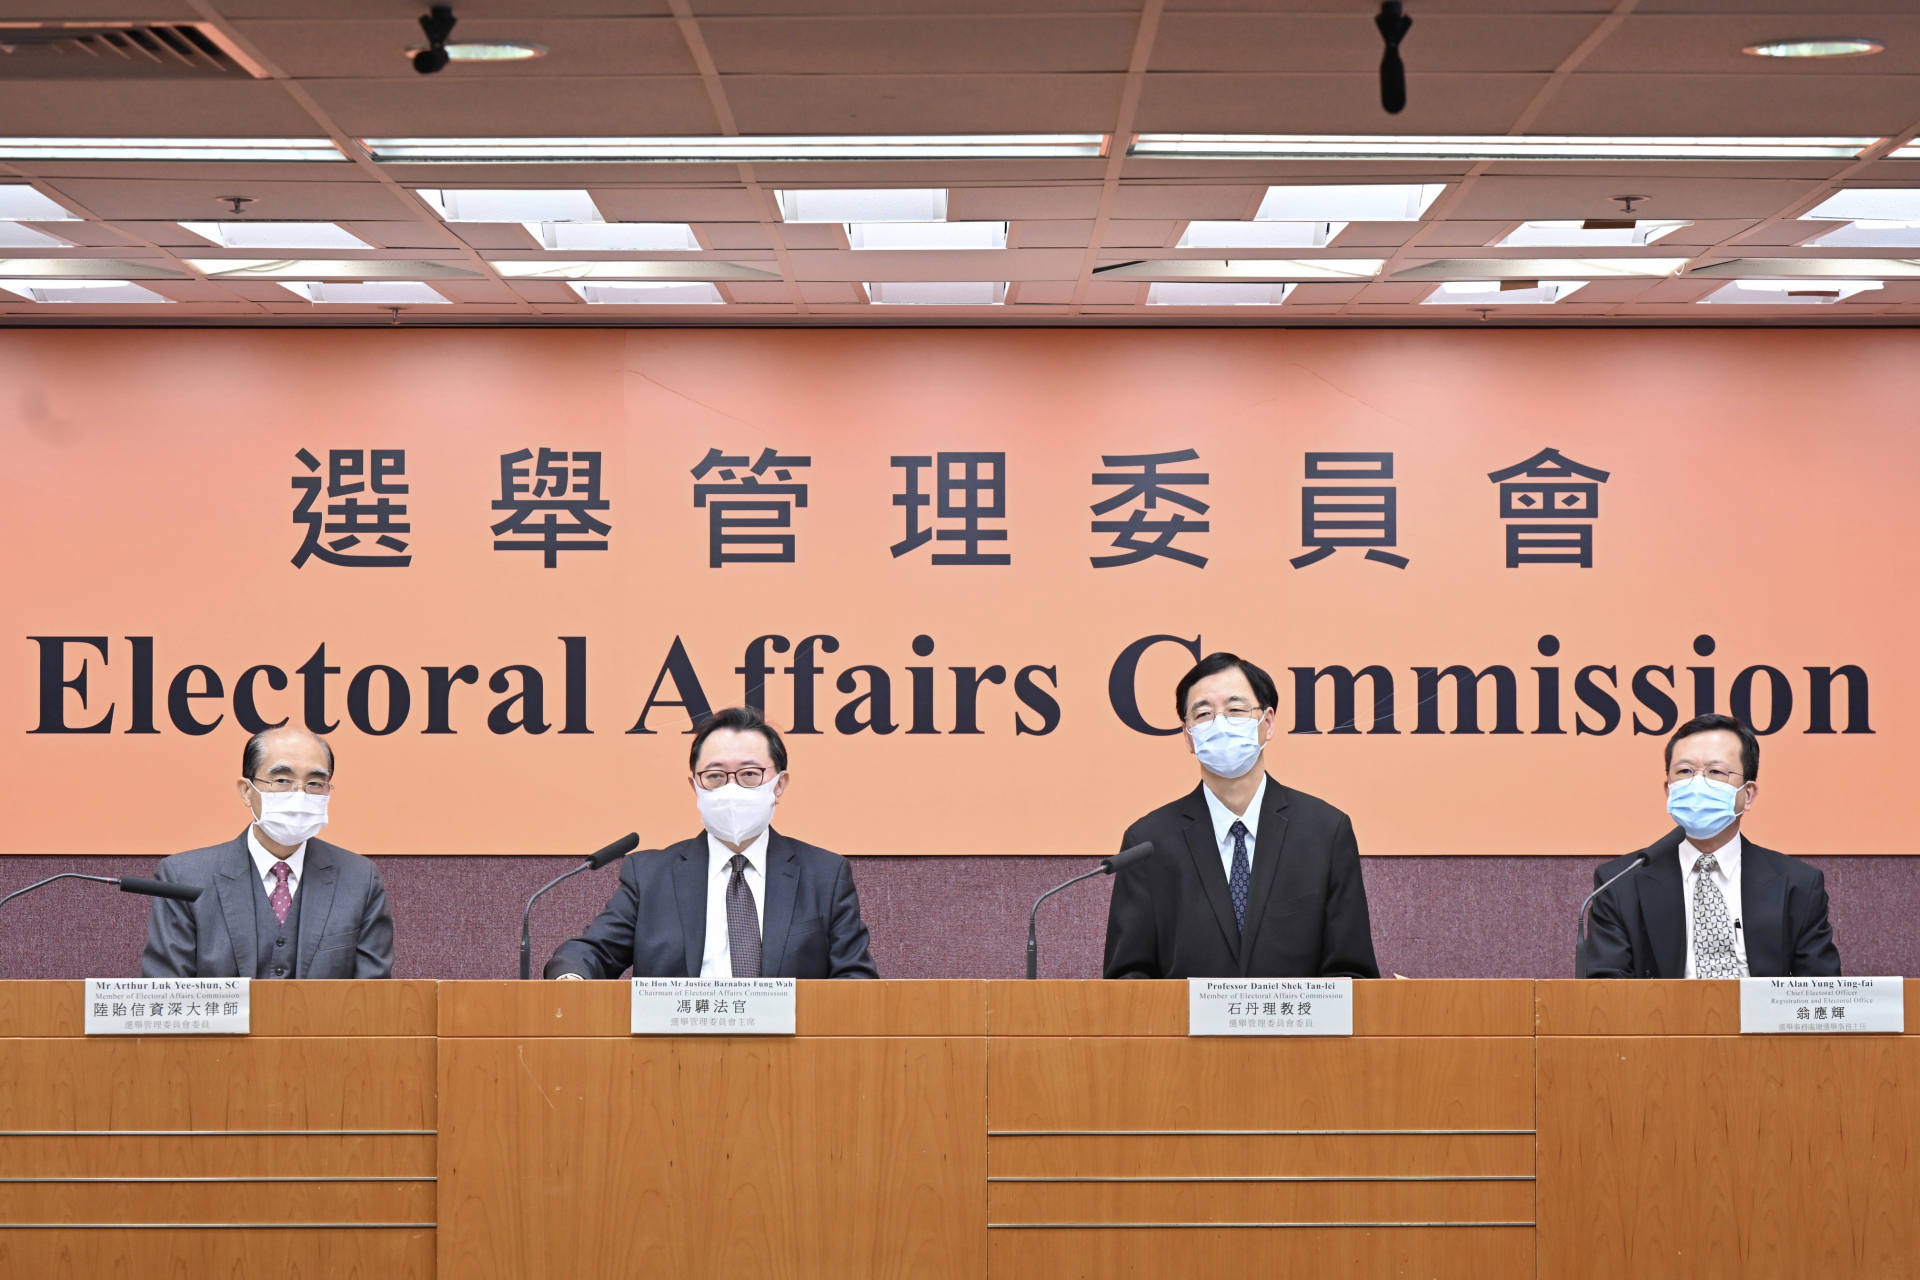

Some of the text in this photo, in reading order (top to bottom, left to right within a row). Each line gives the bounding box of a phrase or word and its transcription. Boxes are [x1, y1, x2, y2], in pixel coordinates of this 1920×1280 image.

[290, 447, 1611, 569] 選舉管理委員會
[26, 634, 1876, 736] Electoral Affairs Cmmission
[175, 982, 222, 990] Yee-shun,
[225, 981, 239, 989] SC
[1812, 980, 1834, 988] Yung
[1837, 980, 1873, 988] Ying-fai
[94, 1002, 238, 1017] 陸貽信資深大律師
[677, 999, 747, 1014] 馮驊法官
[1228, 1002, 1312, 1015] 石丹理教授
[1796, 1006, 1845, 1019] 翁應輝
